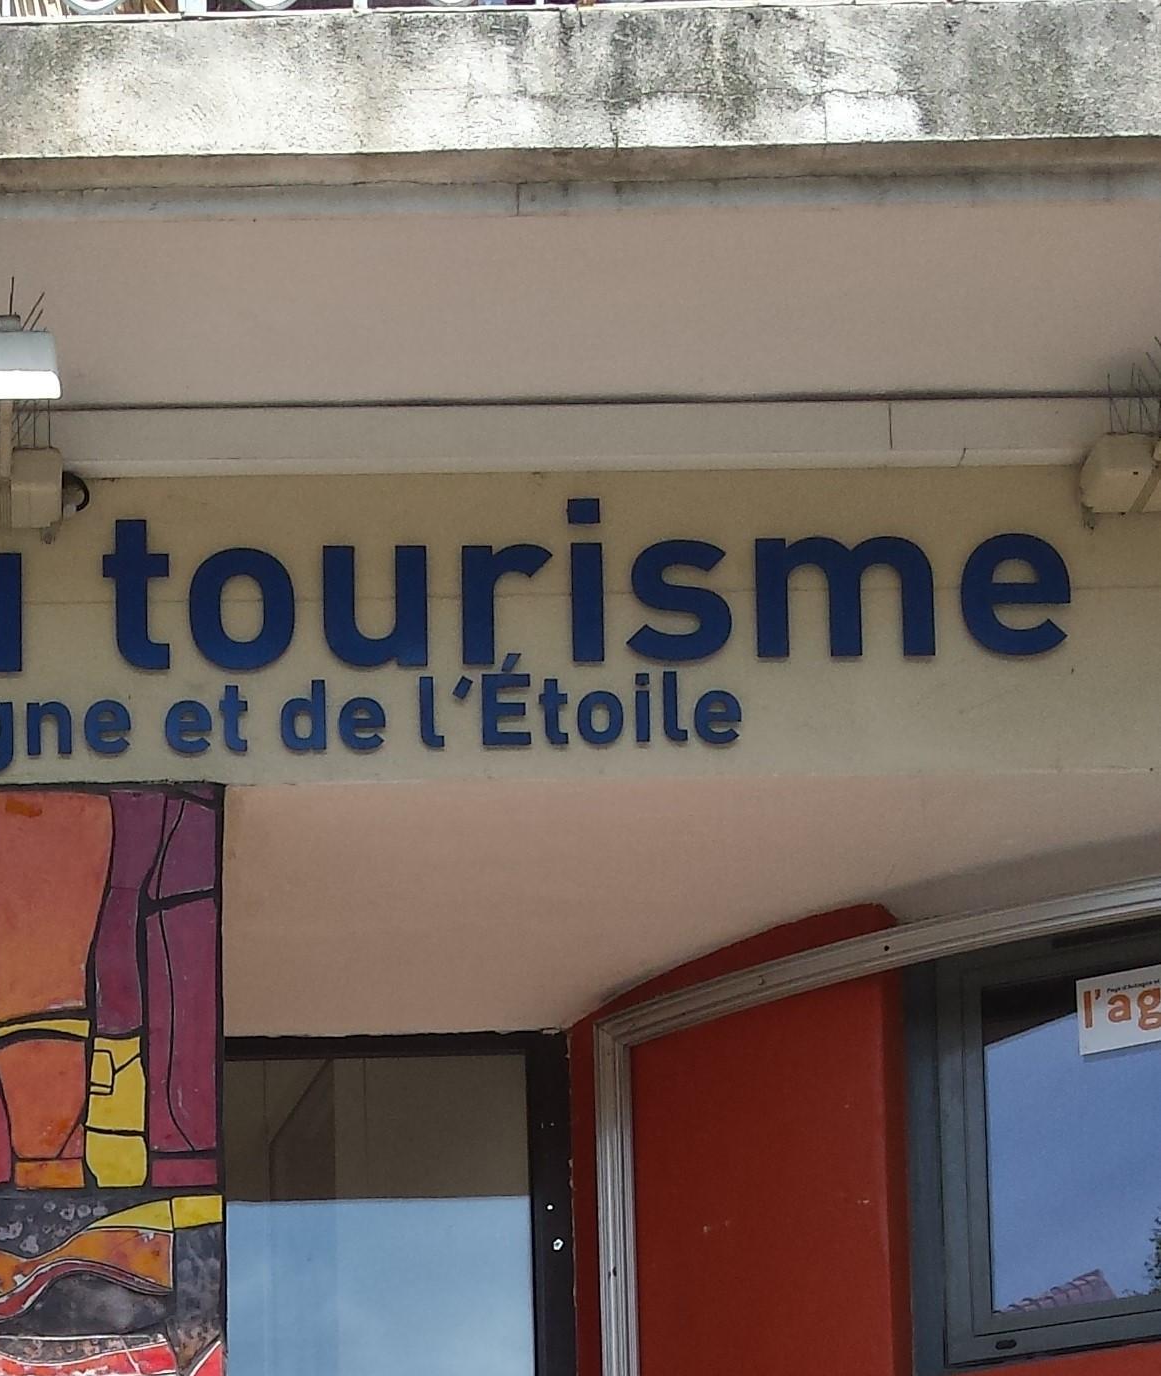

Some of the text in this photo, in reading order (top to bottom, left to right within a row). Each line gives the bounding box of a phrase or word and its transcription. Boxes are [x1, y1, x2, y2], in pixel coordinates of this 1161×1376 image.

[105, 500, 1069, 671] tourisme
[165, 686, 247, 753] et
[281, 680, 387, 752] de
[418, 652, 742, 748] l'Étoile
